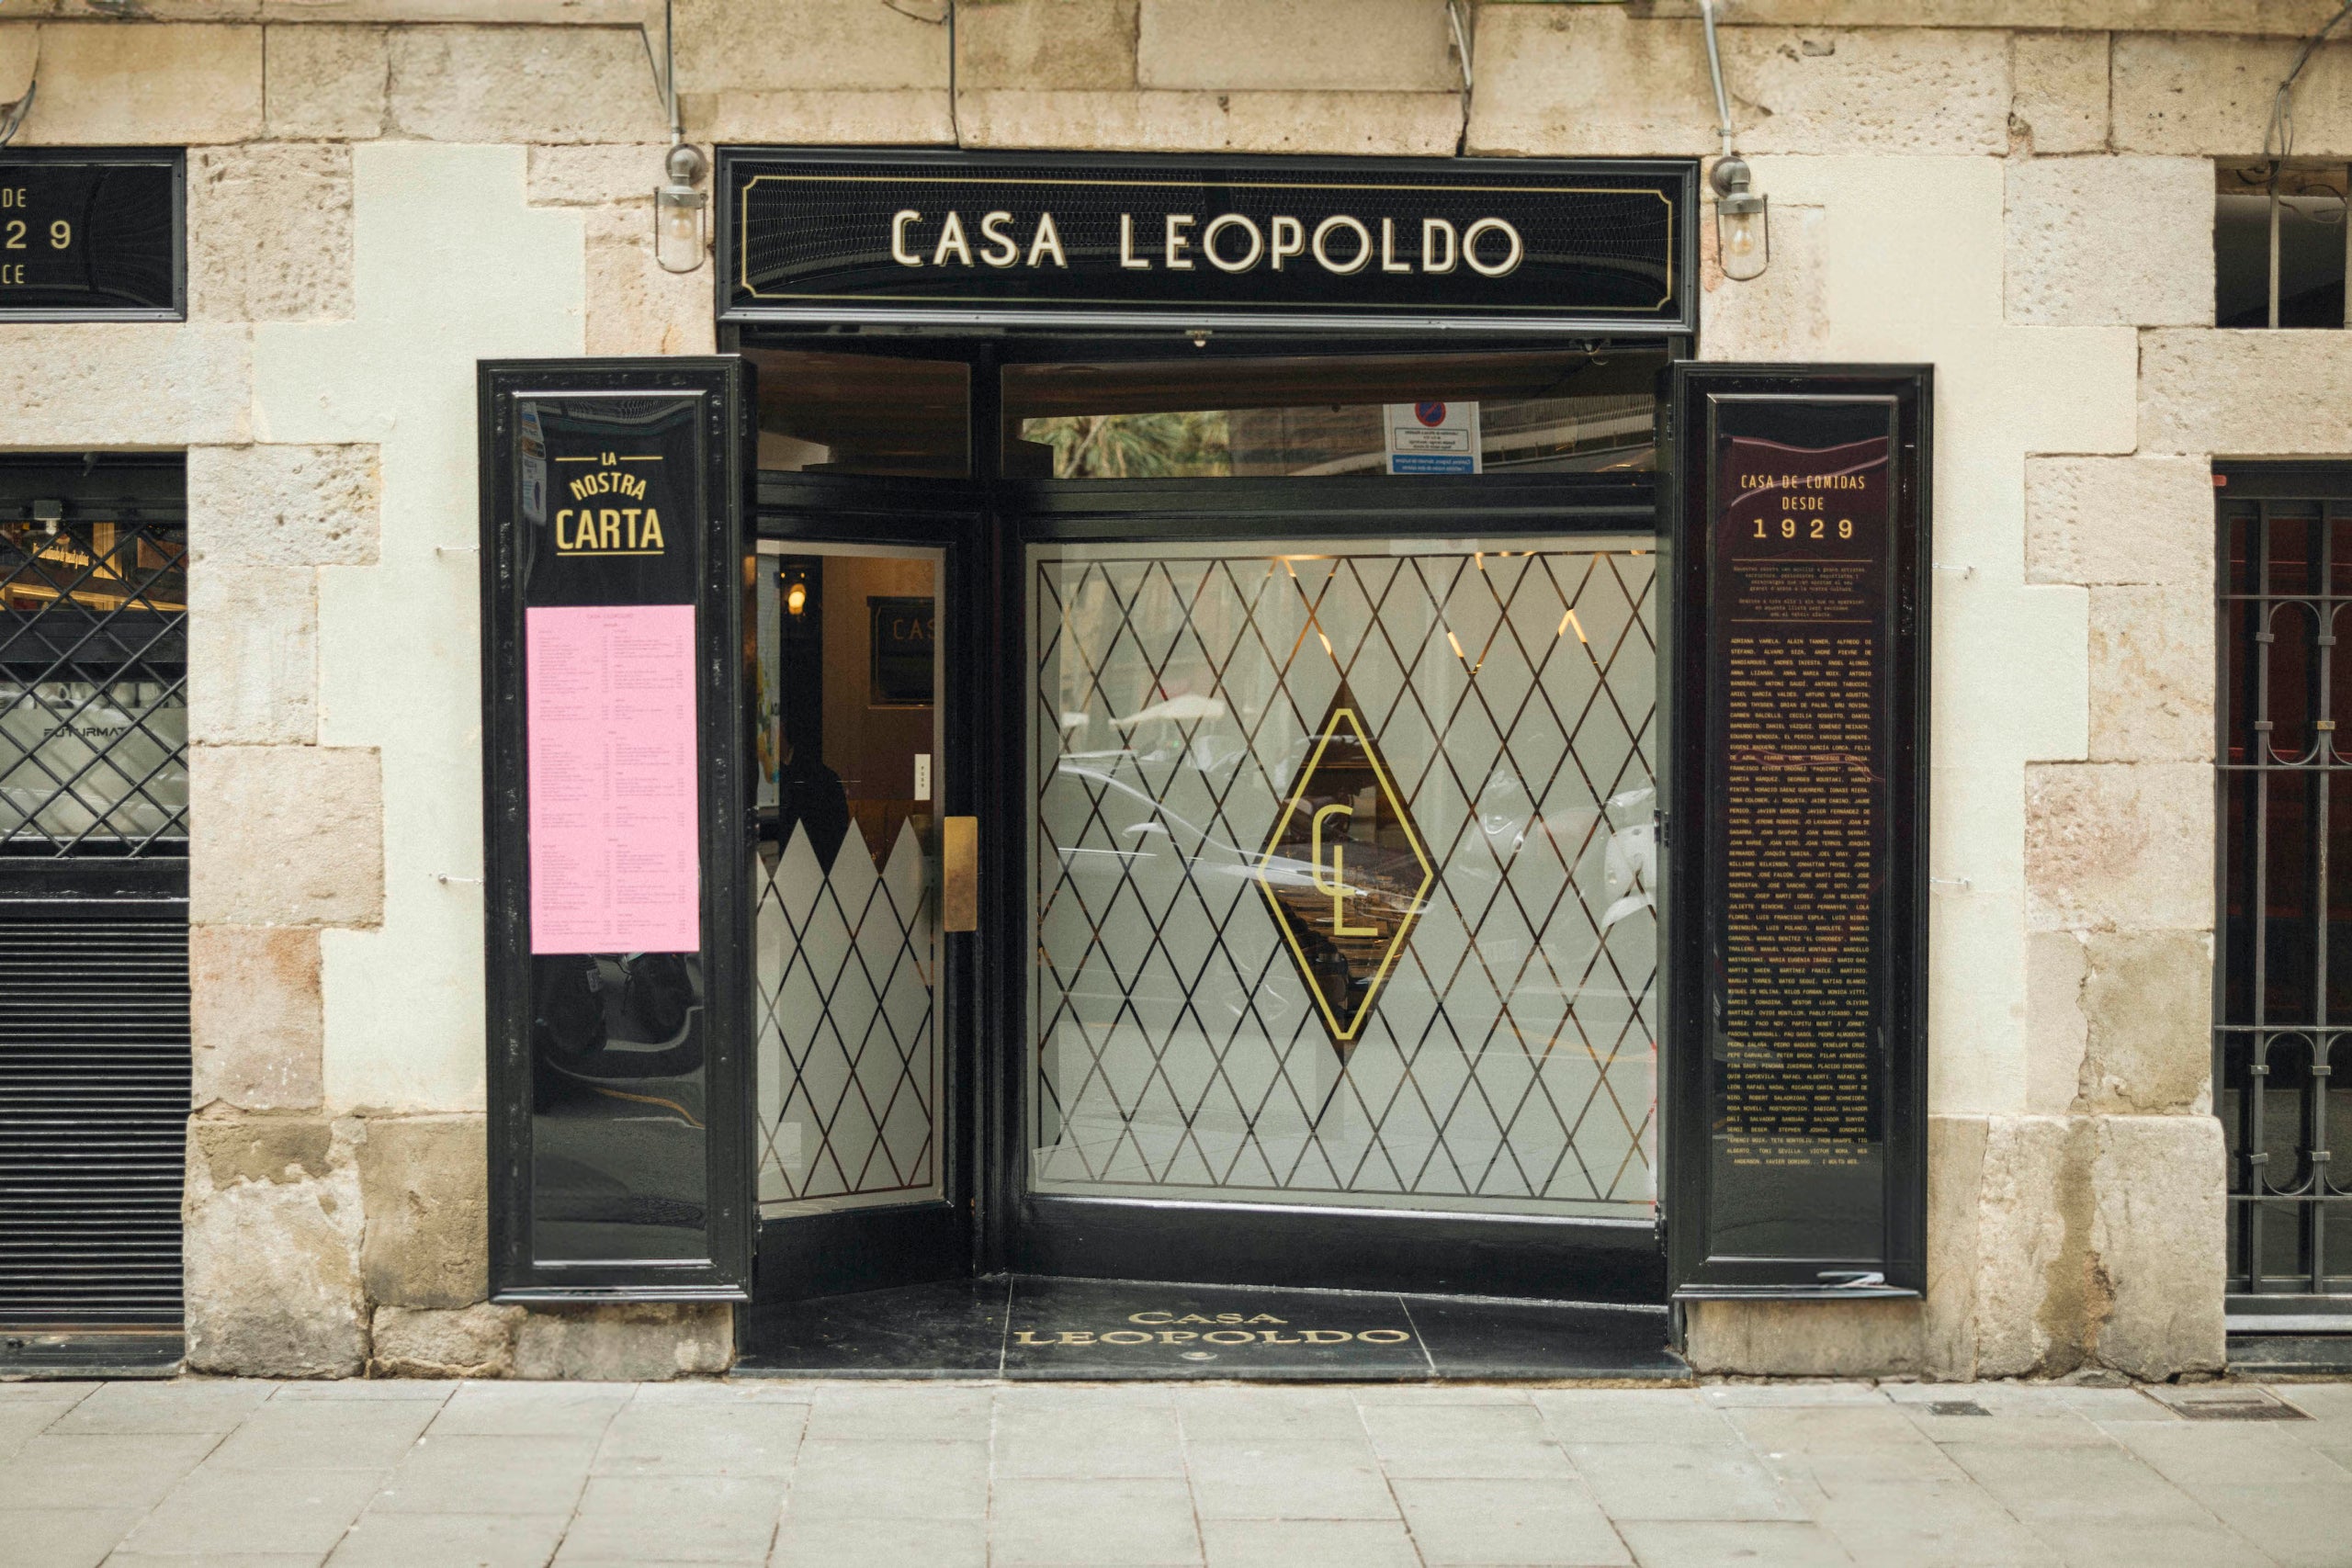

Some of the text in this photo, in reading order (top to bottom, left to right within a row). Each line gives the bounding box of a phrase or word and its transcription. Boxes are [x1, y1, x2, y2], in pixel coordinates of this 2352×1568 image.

[891, 210, 1523, 277] CASA LEOPOLDO
[602, 451, 617, 467] LA
[569, 471, 648, 502] NOSTRA
[1741, 474, 1866, 490] CASA DE COMIDAS
[1781, 496, 1825, 511] DESDE
[556, 508, 664, 550] CARTA
[1127, 1312, 1288, 1325] CASA
[1013, 1329, 1411, 1346] LEOPOLDO
